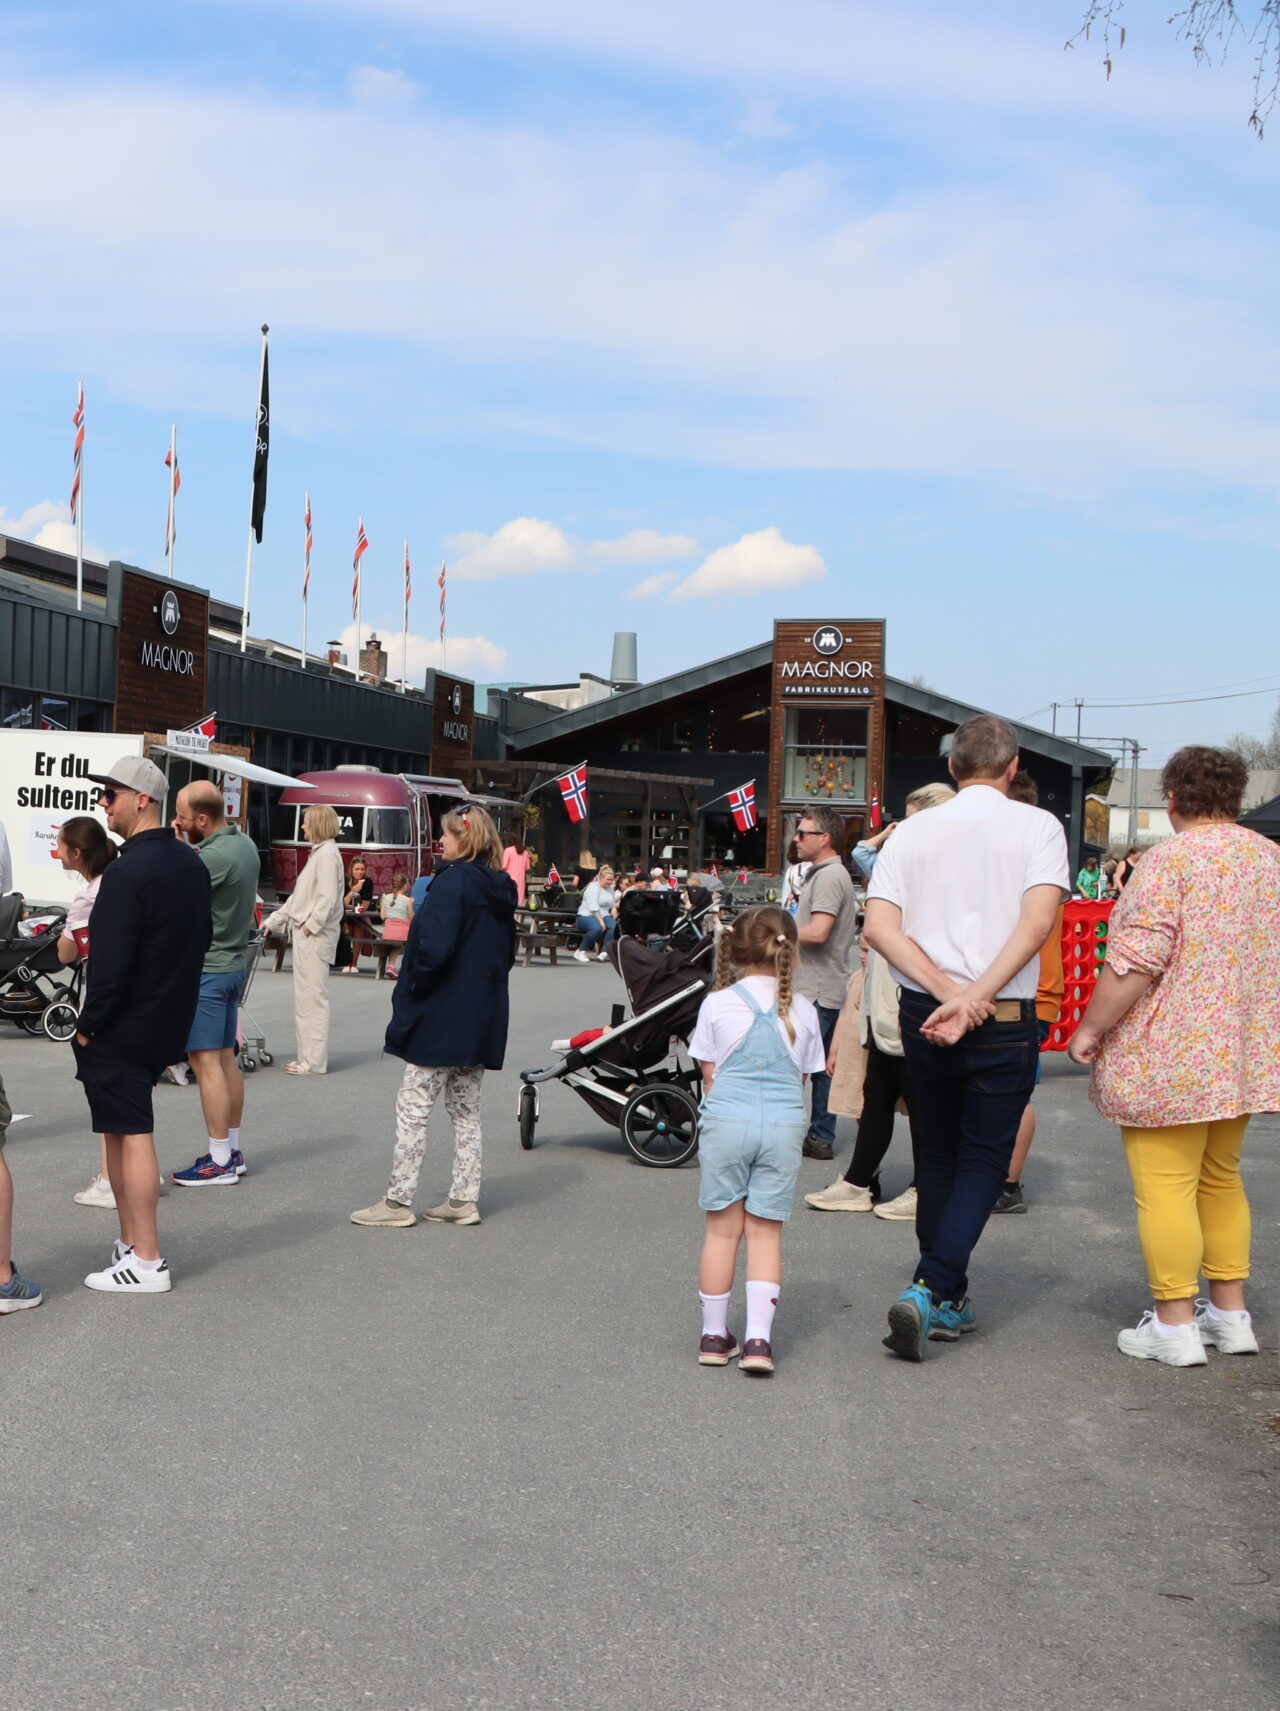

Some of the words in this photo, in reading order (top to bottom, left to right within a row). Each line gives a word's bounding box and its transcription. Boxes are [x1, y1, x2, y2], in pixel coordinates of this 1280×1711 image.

[141, 640, 195, 677] MAGNOR
[781, 660, 874, 679] MAGNOR
[785, 686, 870, 694] FABRIKKUTSALG
[443, 720, 468, 742] MAGNOR
[34, 751, 56, 777] Er
[61, 753, 90, 779] du
[17, 784, 104, 812] sulten?
